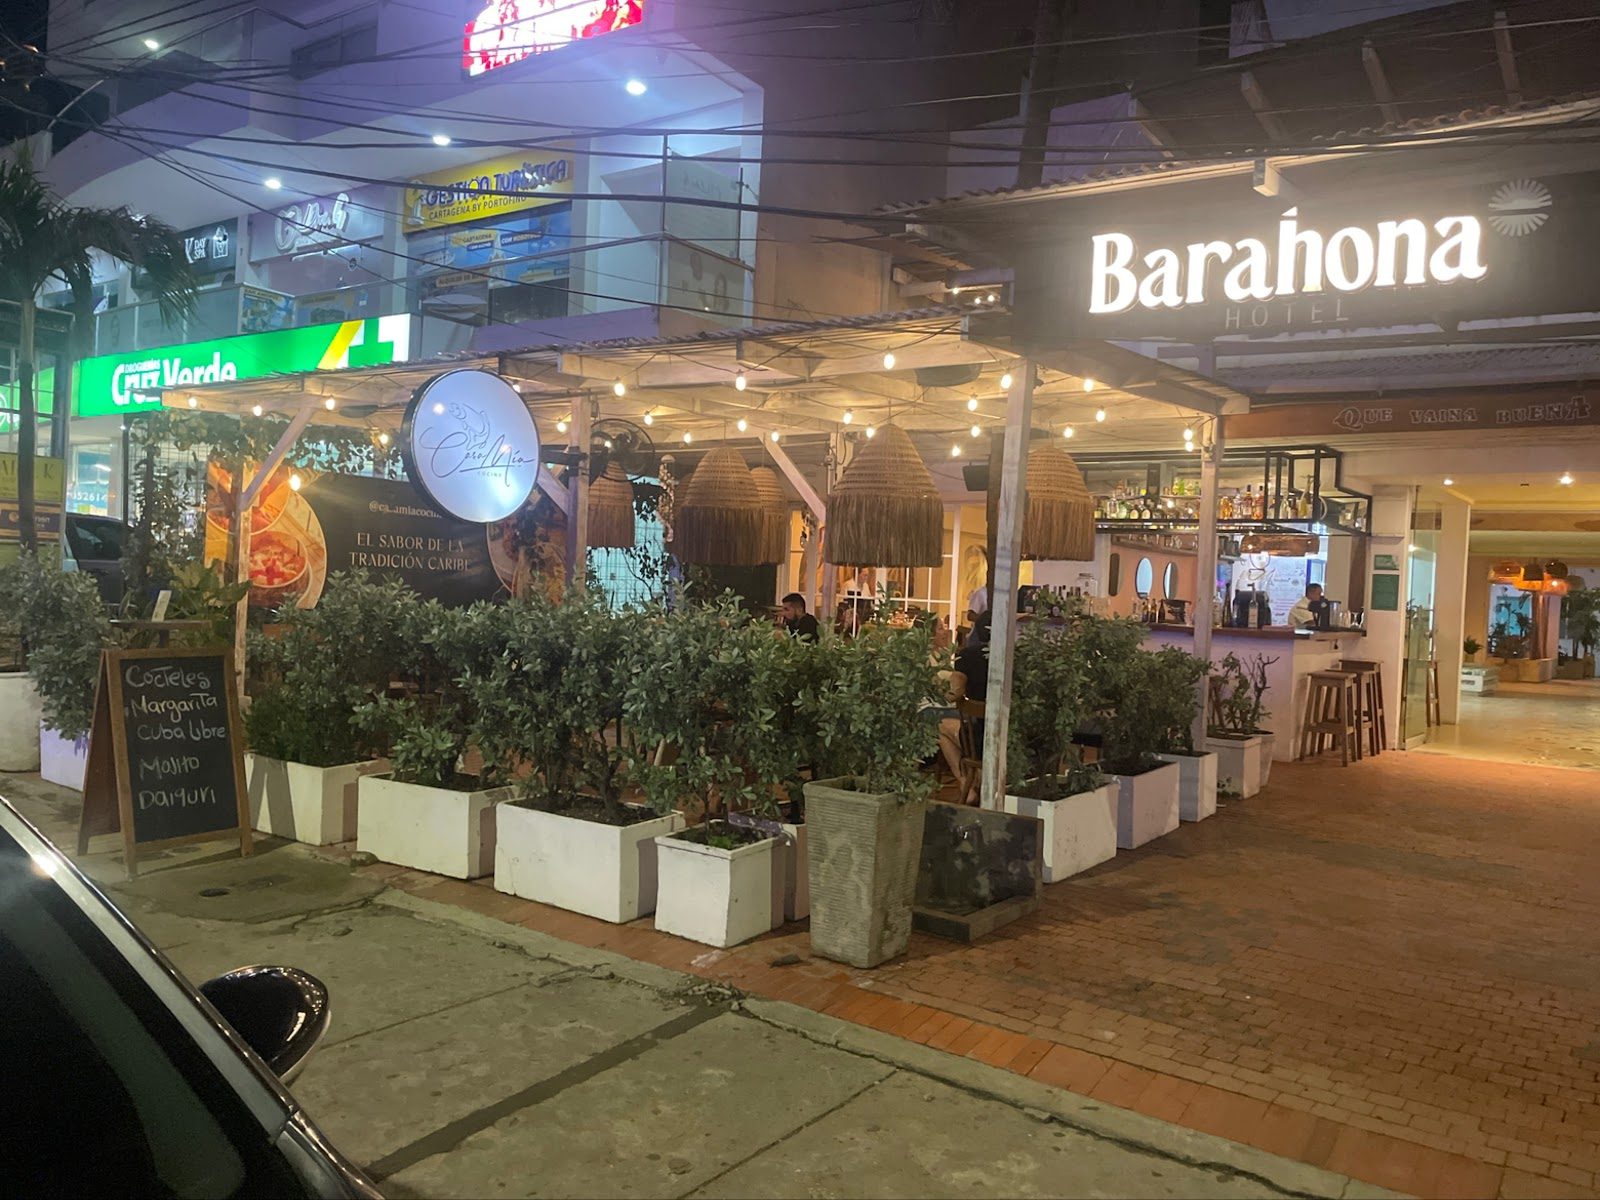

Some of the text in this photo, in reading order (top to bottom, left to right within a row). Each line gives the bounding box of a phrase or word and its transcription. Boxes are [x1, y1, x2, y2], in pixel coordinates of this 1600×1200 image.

[429, 195, 527, 220] CARTAGENA BY PORTOFINO
[1088, 206, 1488, 313] Barahona
[1225, 299, 1349, 330] HOTEL
[163, 352, 237, 386] Verde
[1333, 395, 1592, 431] QUE VAINA BUENA
[357, 532, 465, 553] EL SABOR DE LA
[349, 551, 423, 570] TRADICIÓN
[137, 722, 185, 741] Cuba
